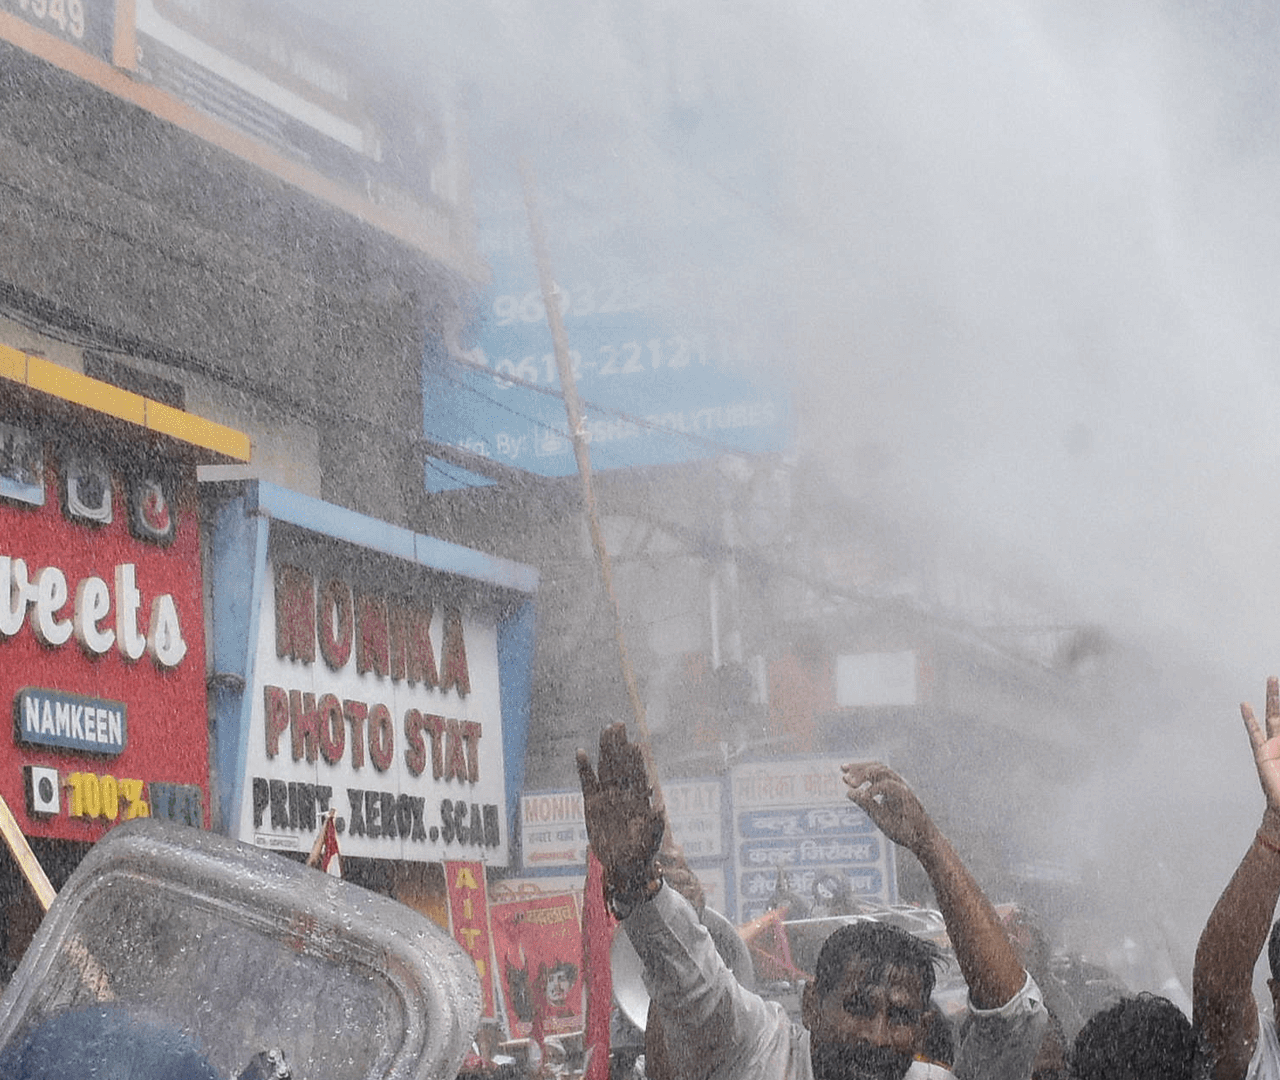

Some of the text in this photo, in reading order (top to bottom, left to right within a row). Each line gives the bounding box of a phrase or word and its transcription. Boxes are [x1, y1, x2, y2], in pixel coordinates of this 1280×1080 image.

[23, 696, 123, 747] NAMKEEN
[263, 684, 483, 784] PHOTO STAT
[64, 771, 151, 822] 100%
